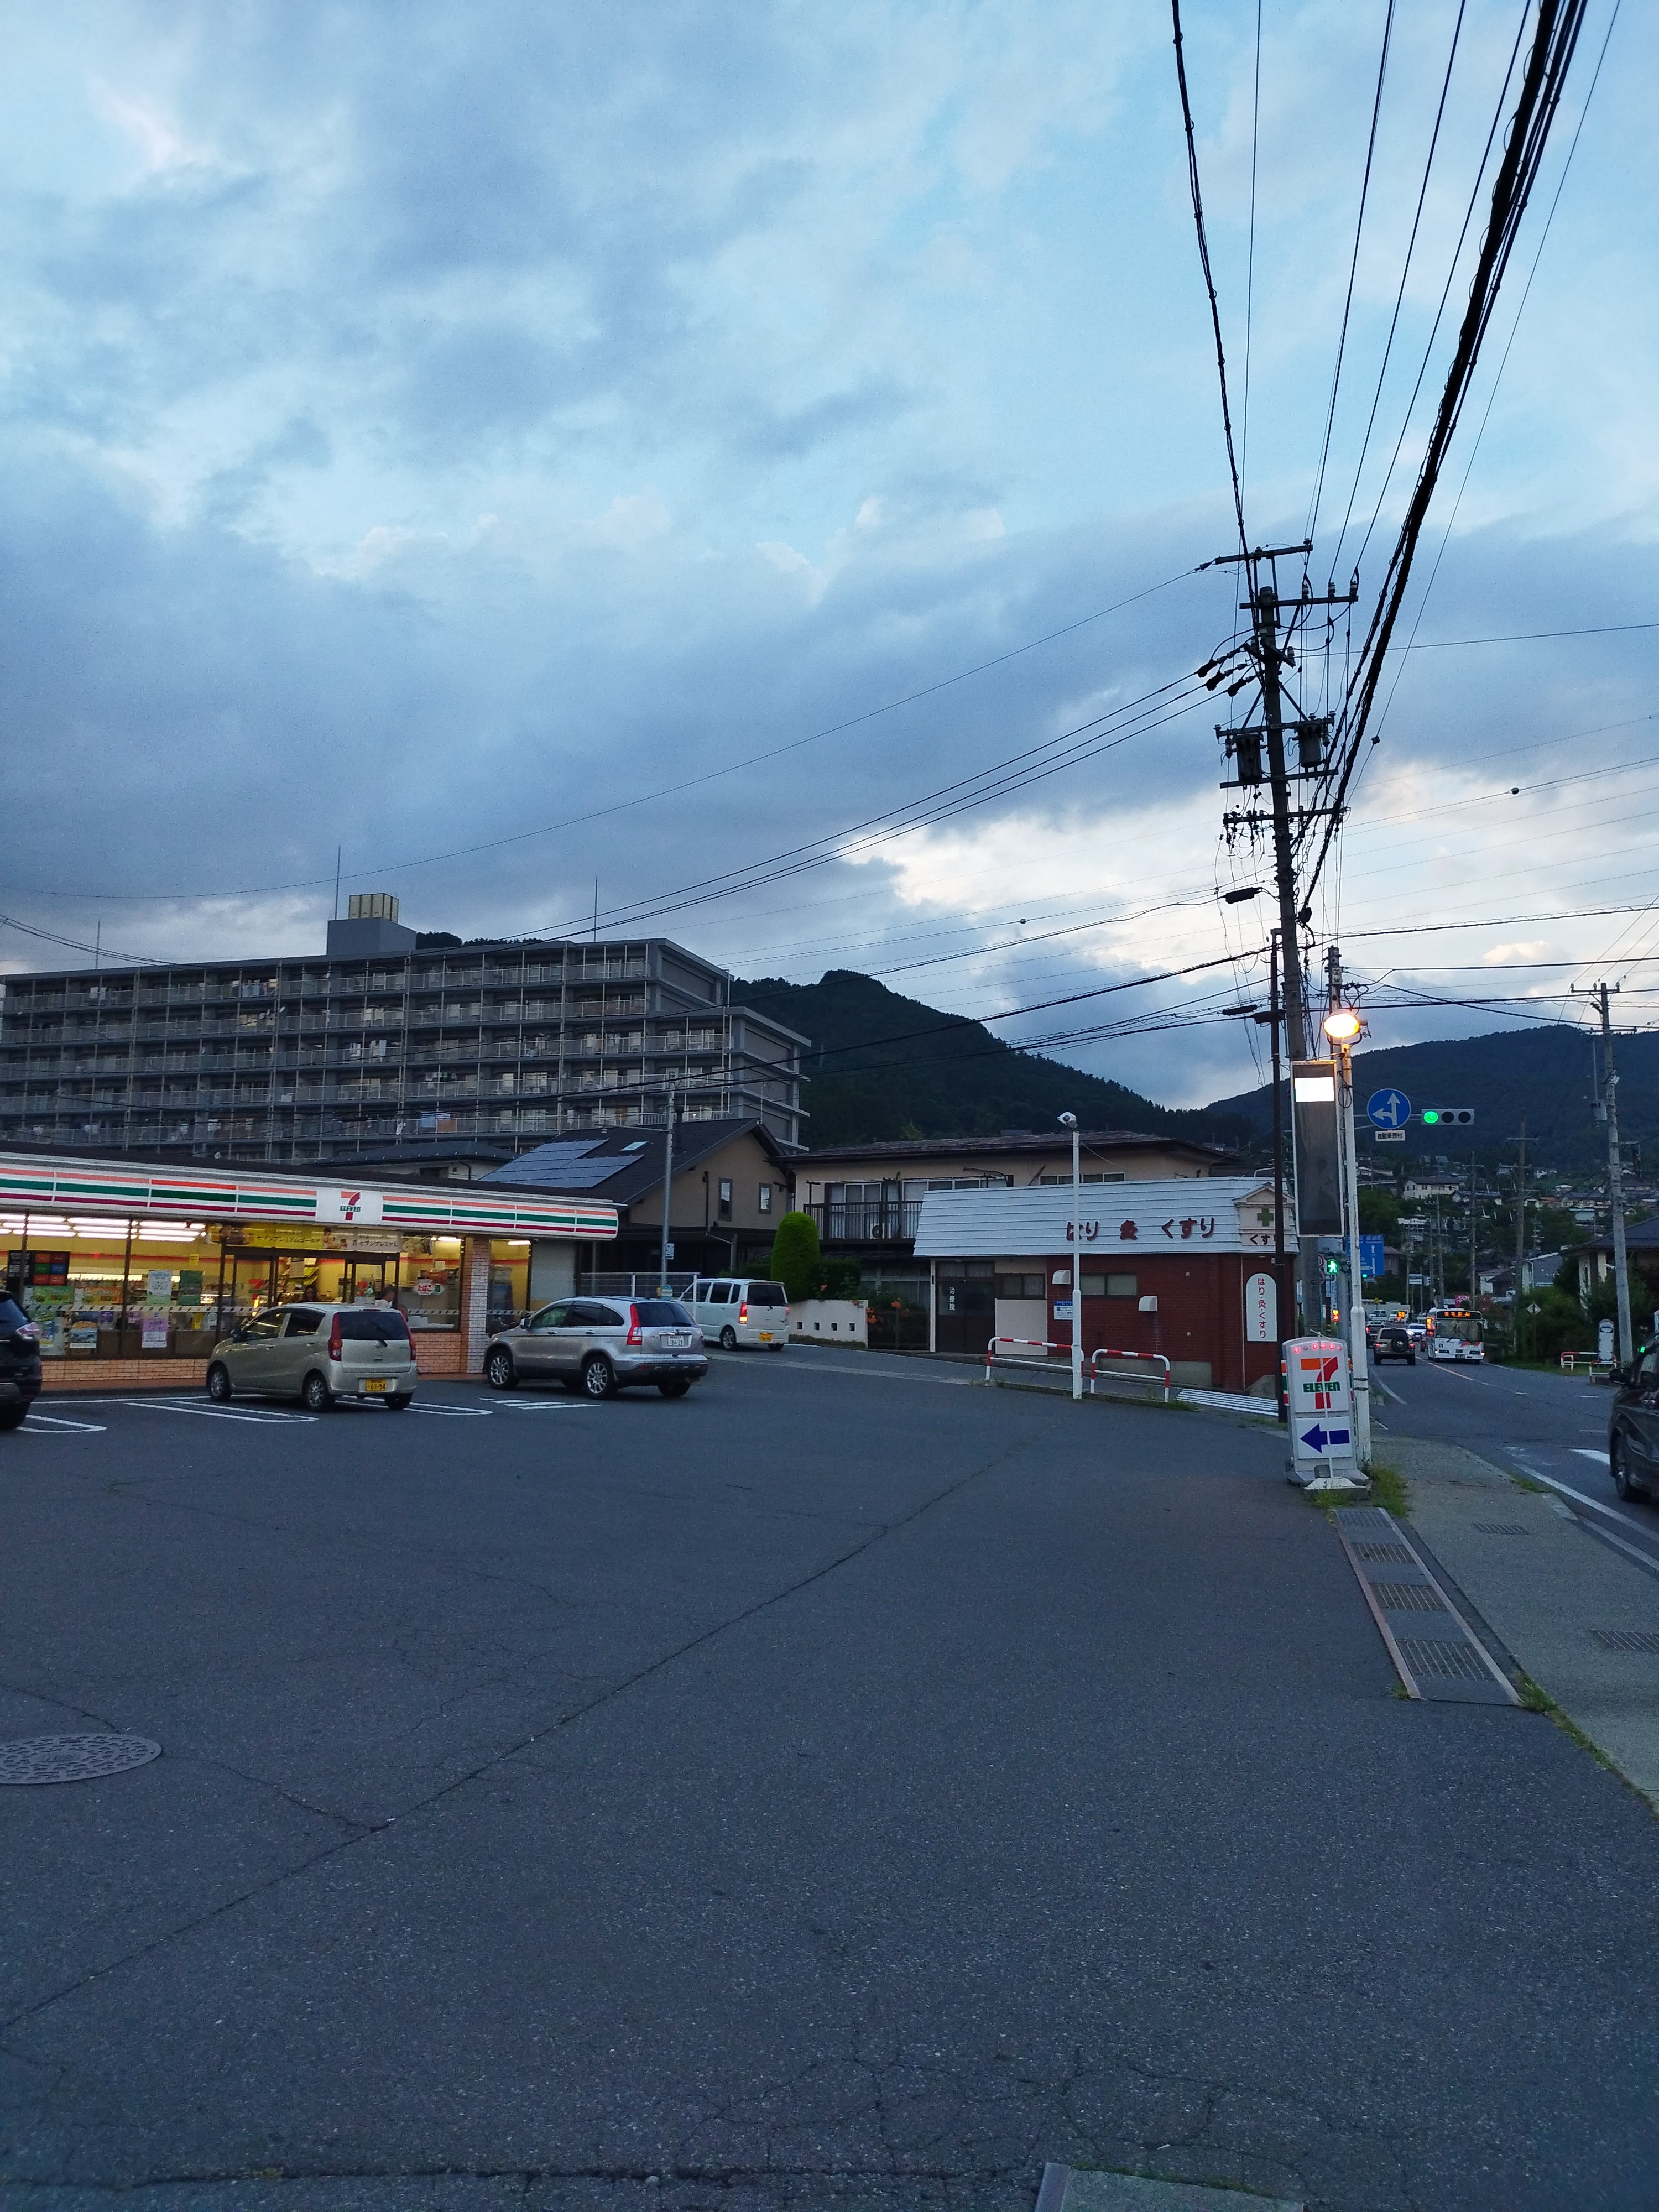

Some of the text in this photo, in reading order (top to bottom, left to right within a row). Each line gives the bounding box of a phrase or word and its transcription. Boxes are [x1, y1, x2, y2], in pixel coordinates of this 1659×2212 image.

[1161, 1217, 1215, 1239] くすり
[1249, 1234, 1276, 1245] くす
